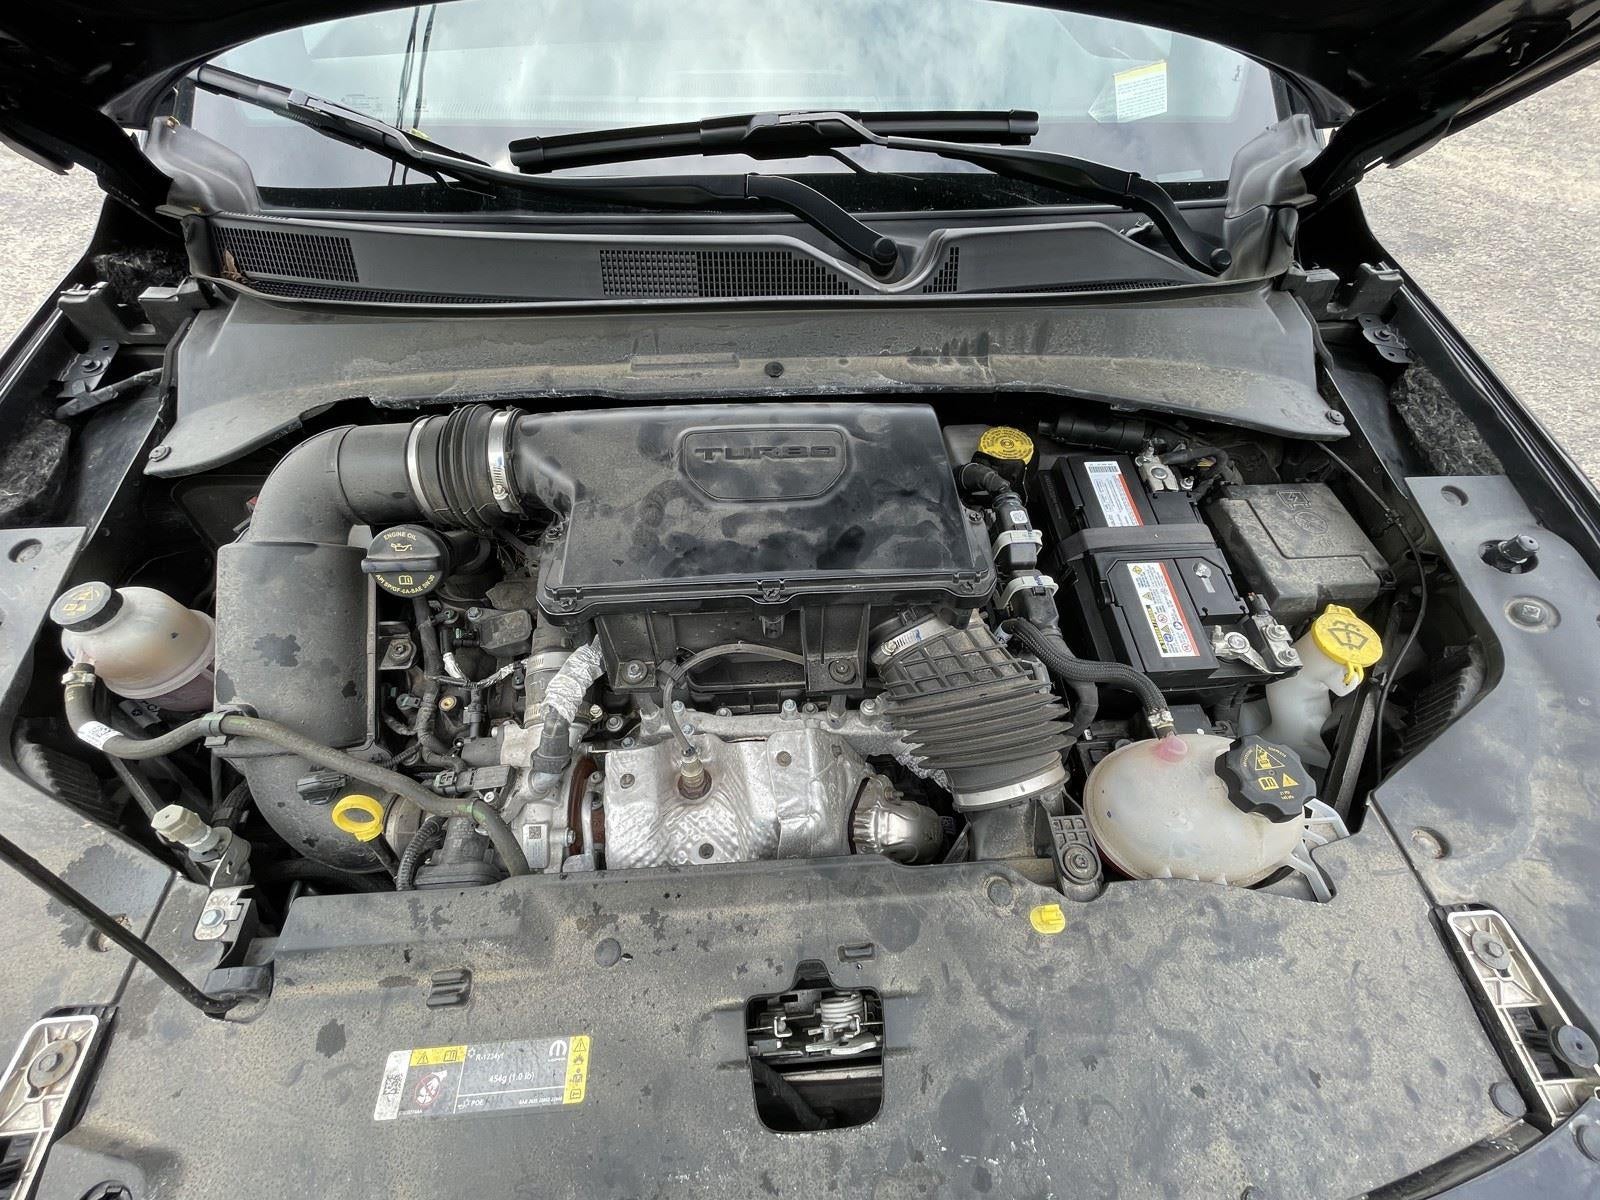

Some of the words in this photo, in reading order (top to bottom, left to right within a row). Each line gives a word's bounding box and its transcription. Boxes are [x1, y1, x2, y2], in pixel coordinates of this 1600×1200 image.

[694, 445, 837, 462] TURBO
[383, 531, 405, 541] ENGINE
[407, 532, 417, 541] OIL
[375, 574, 385, 584] API
[489, 1074, 508, 1084] 454g
